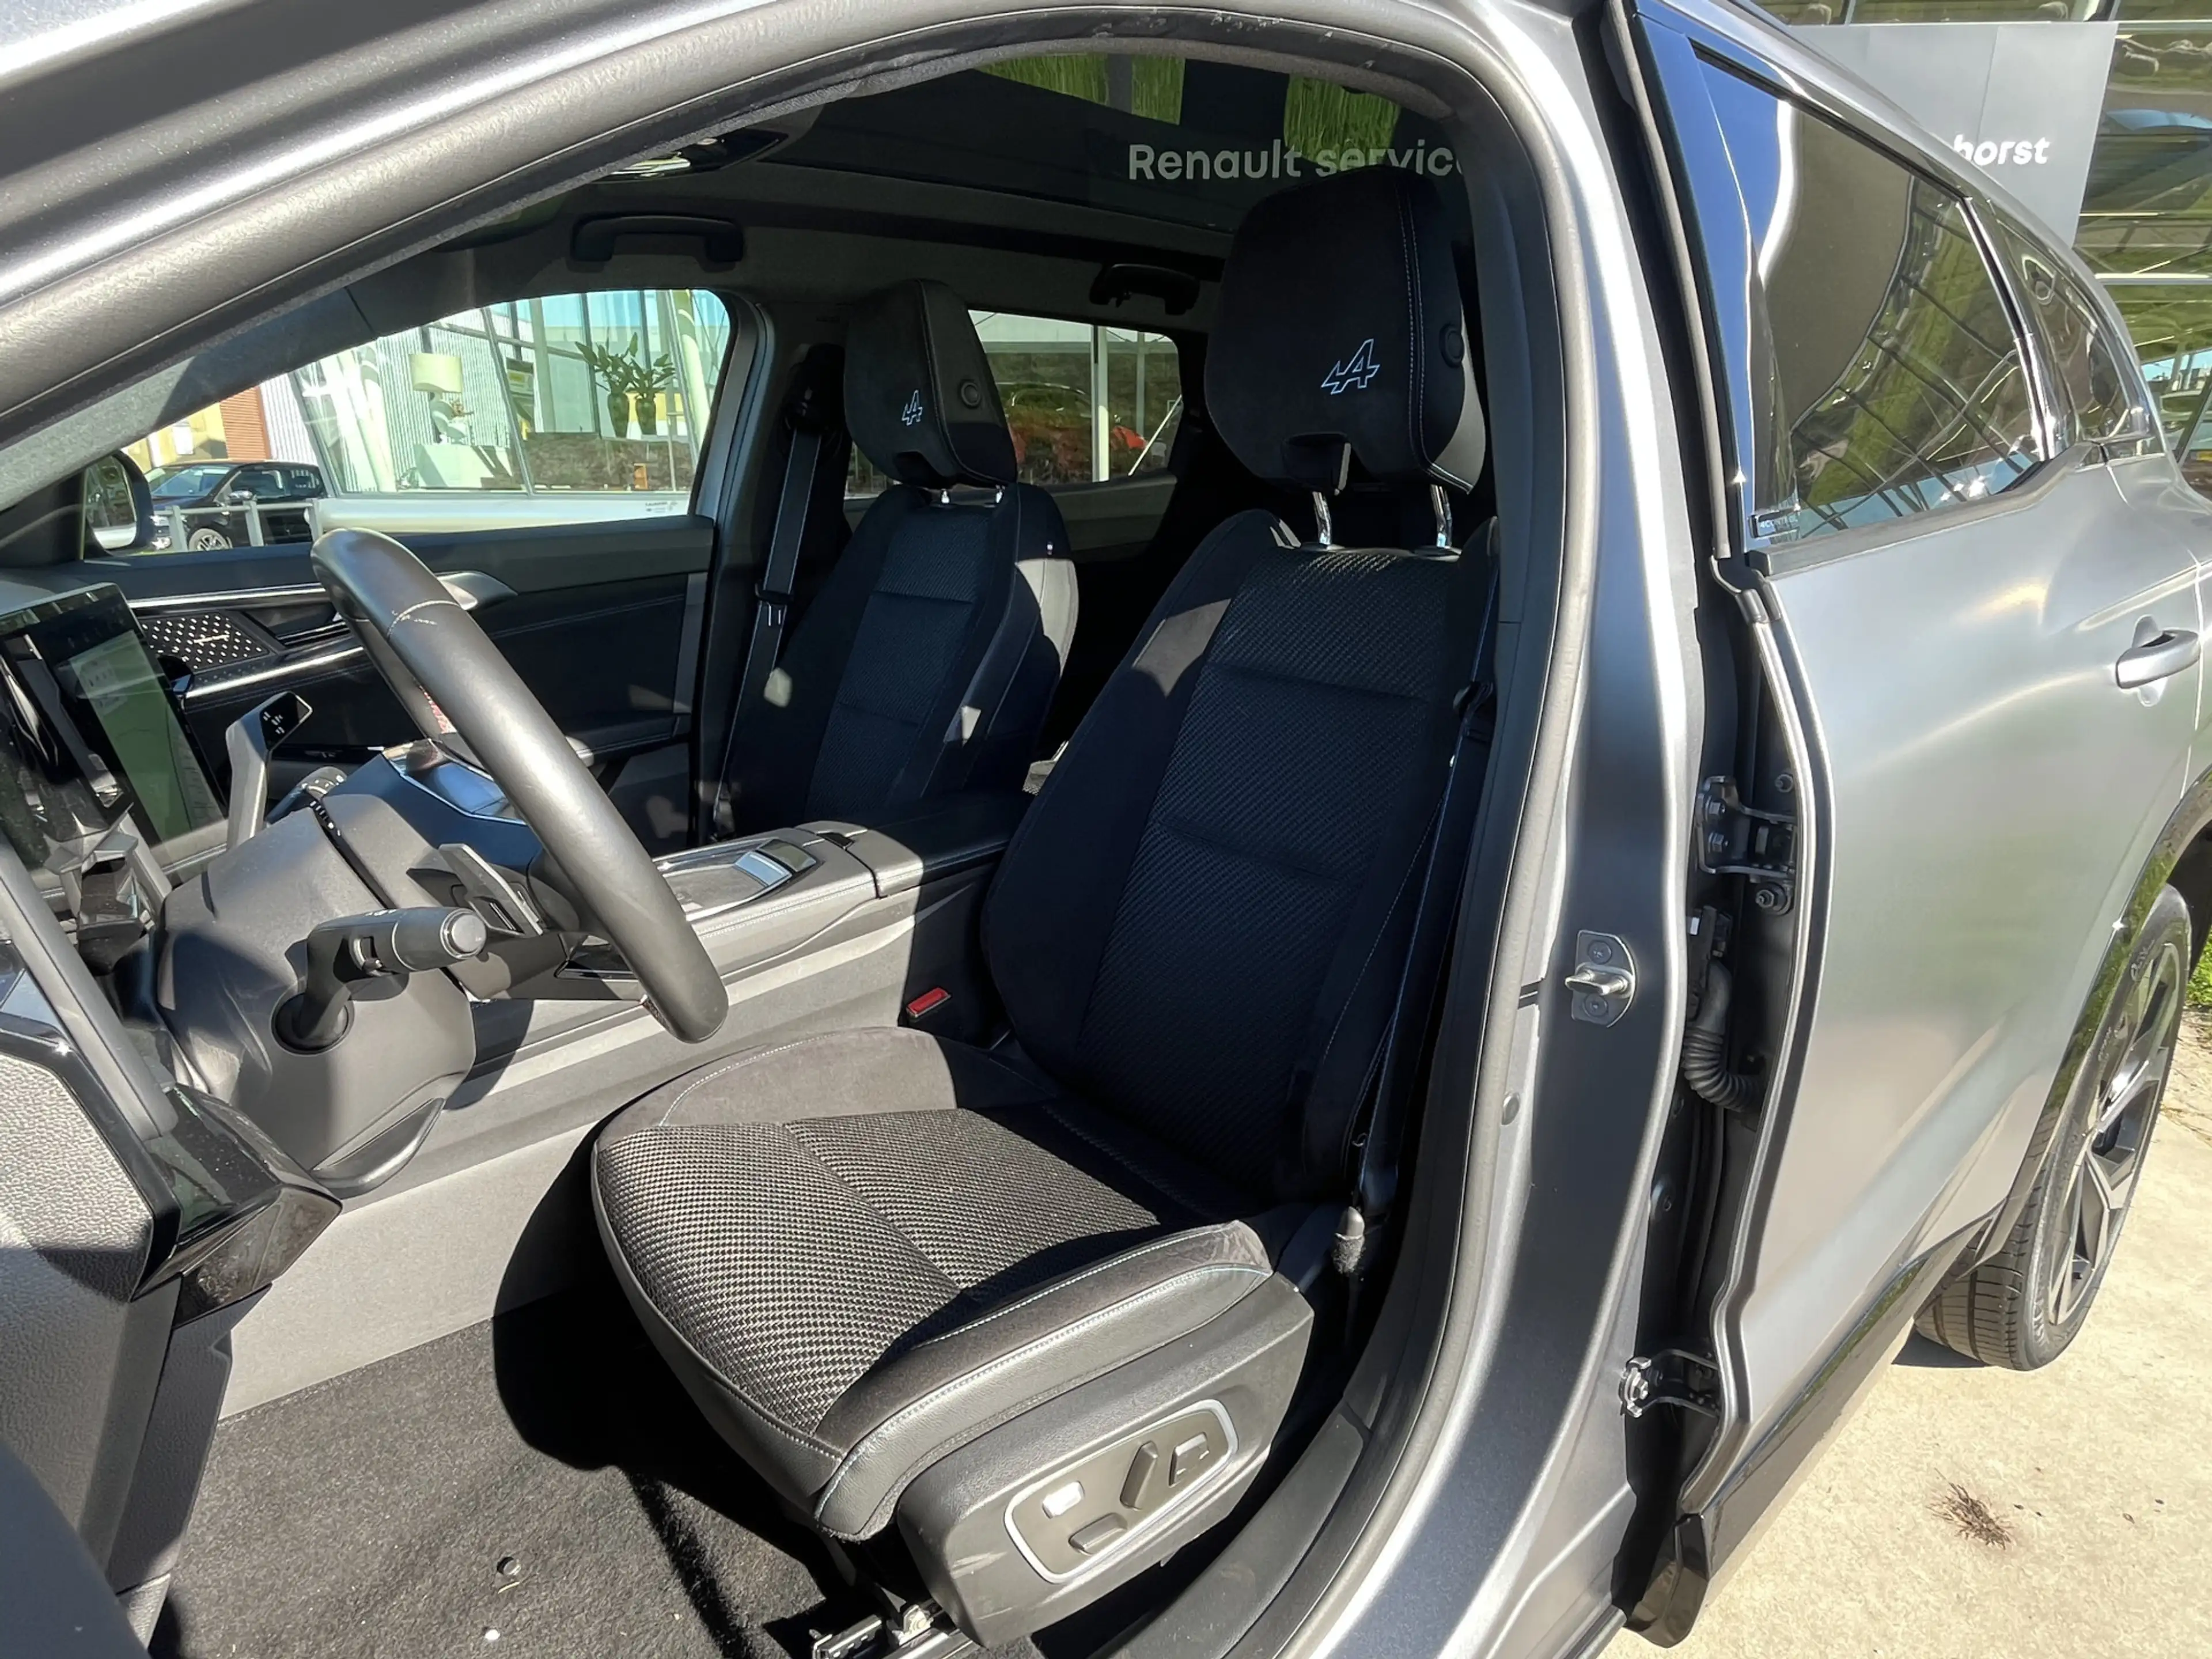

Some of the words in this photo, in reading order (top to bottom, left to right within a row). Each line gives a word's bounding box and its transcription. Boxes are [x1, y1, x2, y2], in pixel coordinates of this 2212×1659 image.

[1128, 139, 1301, 180] Renault
[1315, 139, 1463, 177] servic
[1953, 133, 2051, 166] horst
